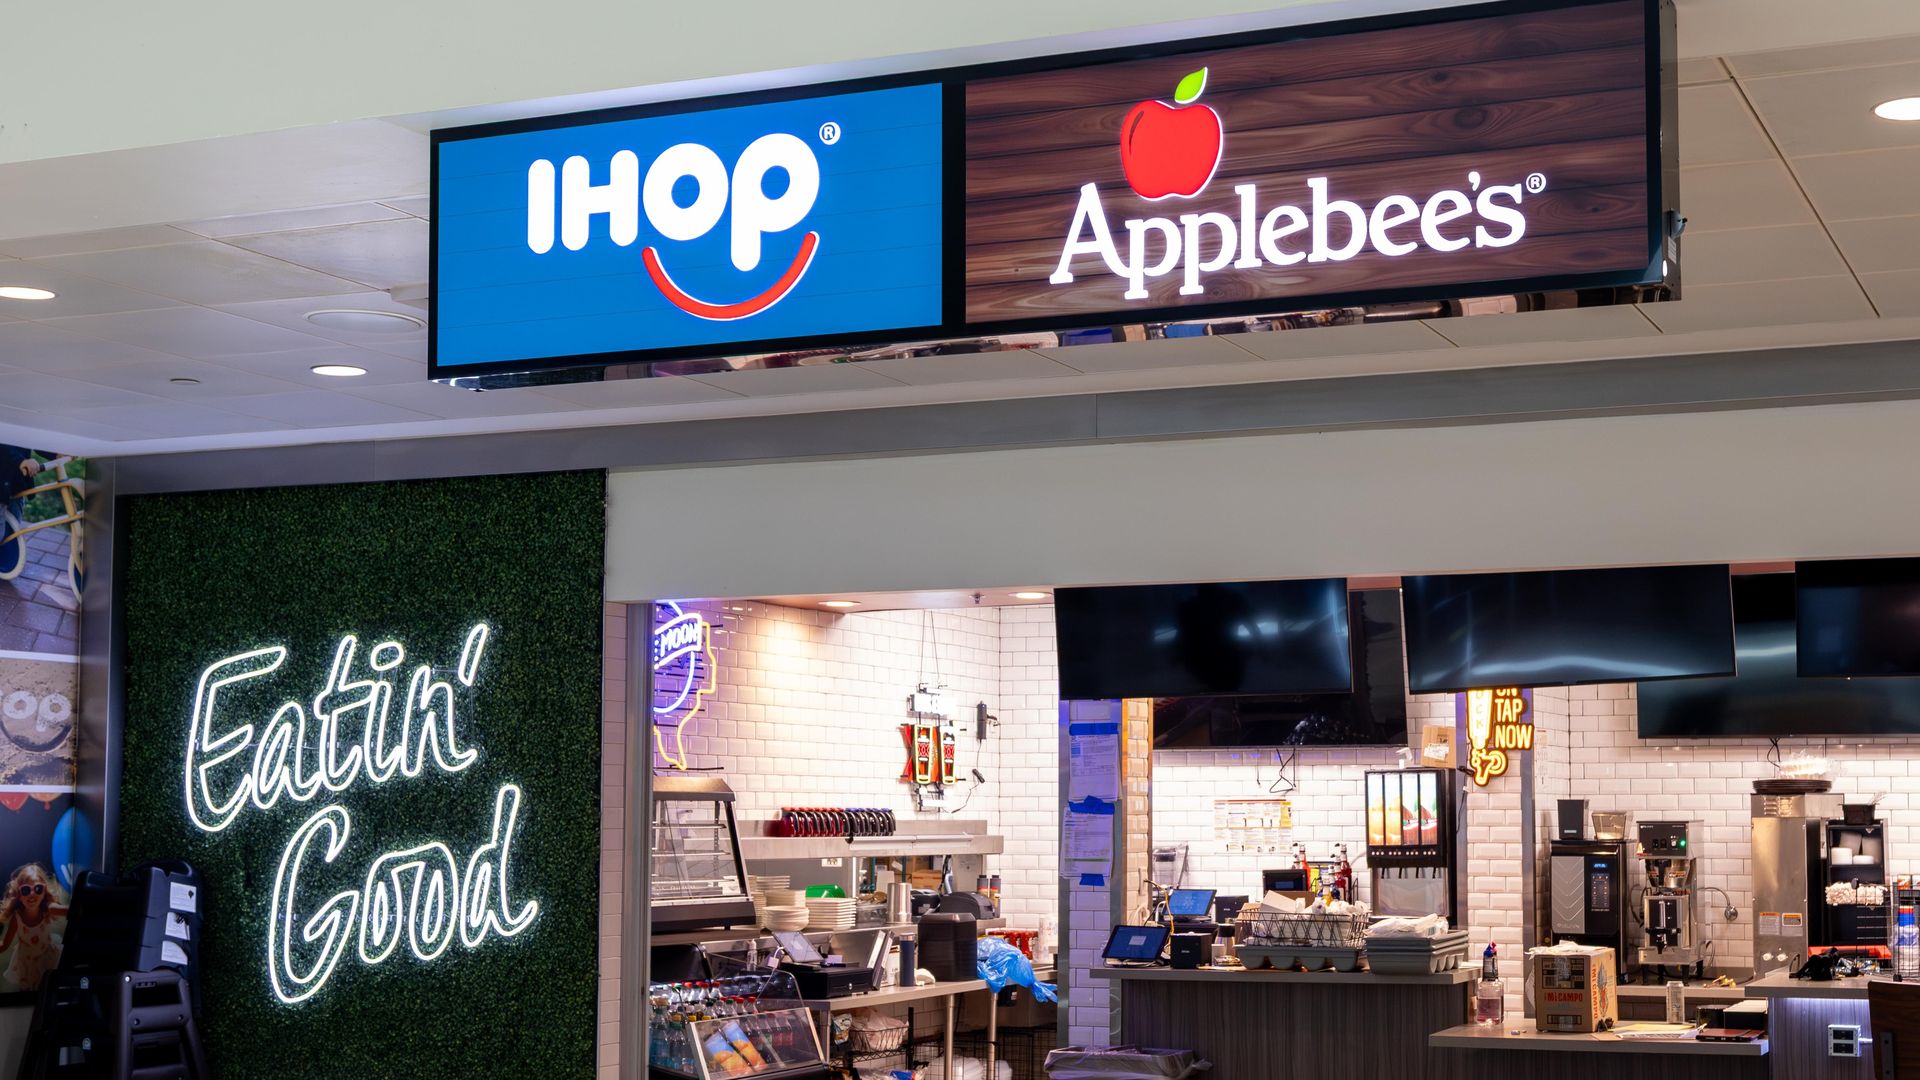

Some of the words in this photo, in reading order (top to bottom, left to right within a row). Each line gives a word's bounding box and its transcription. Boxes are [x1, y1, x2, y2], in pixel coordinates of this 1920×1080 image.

[1049, 171, 1527, 300] Applebee's
[660, 622, 698, 658] MOON
[185, 623, 489, 833] Eatin'
[1495, 698, 1523, 722] TAP
[1495, 725, 1533, 748] NOW
[268, 784, 540, 1005] Good
